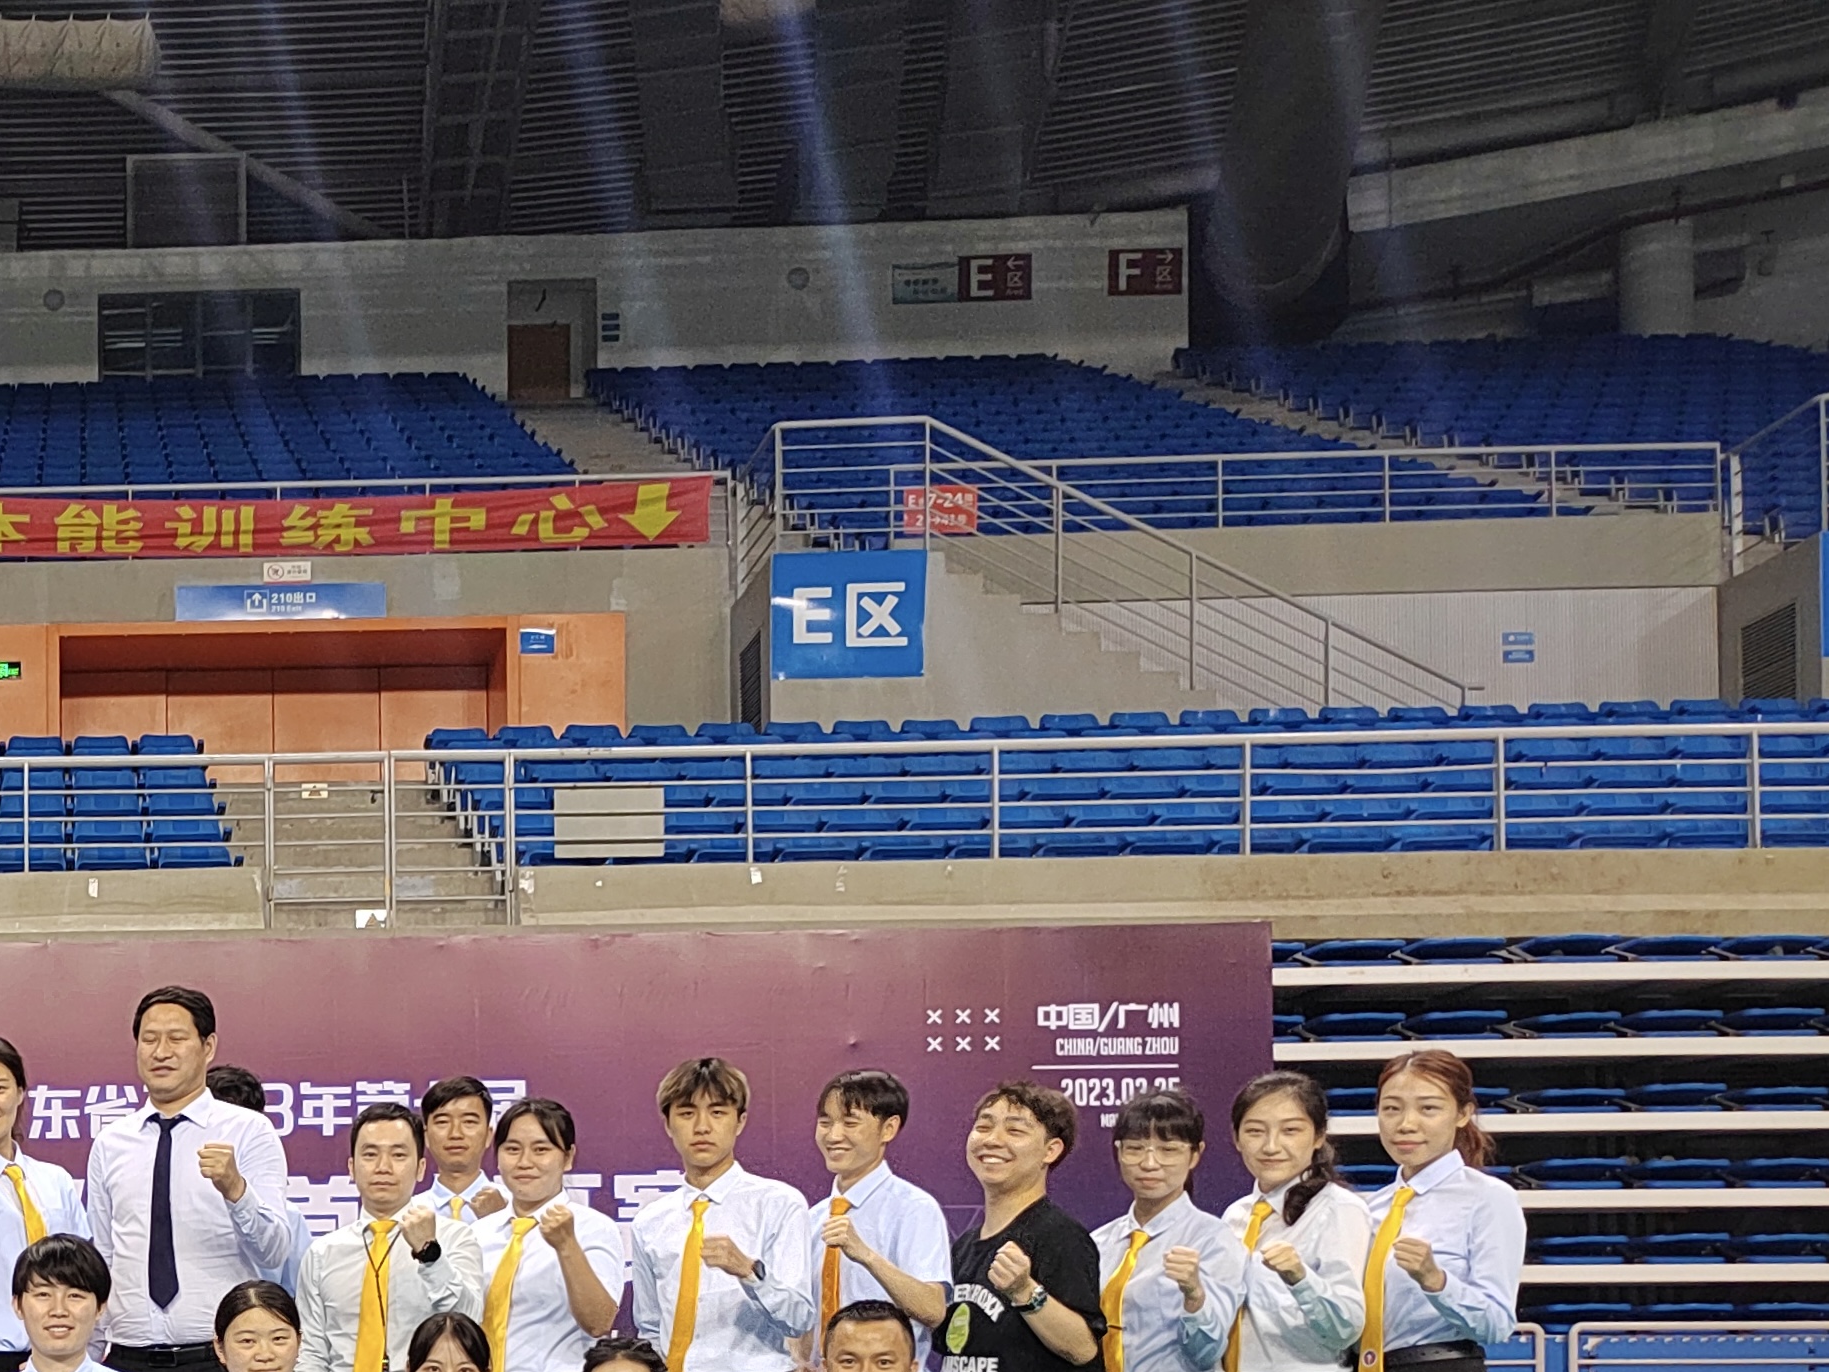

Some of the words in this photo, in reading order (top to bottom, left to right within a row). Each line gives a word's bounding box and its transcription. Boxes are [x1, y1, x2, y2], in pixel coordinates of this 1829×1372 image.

[970, 259, 994, 297] E
[1118, 252, 1143, 291] F
[271, 591, 317, 604] 210出口
[792, 581, 909, 648] E区
[1037, 1001, 1180, 1032] 中国/广州
[1055, 1036, 1143, 1056] CHINA/GUANG
[1144, 1036, 1180, 1055] ZHOU
